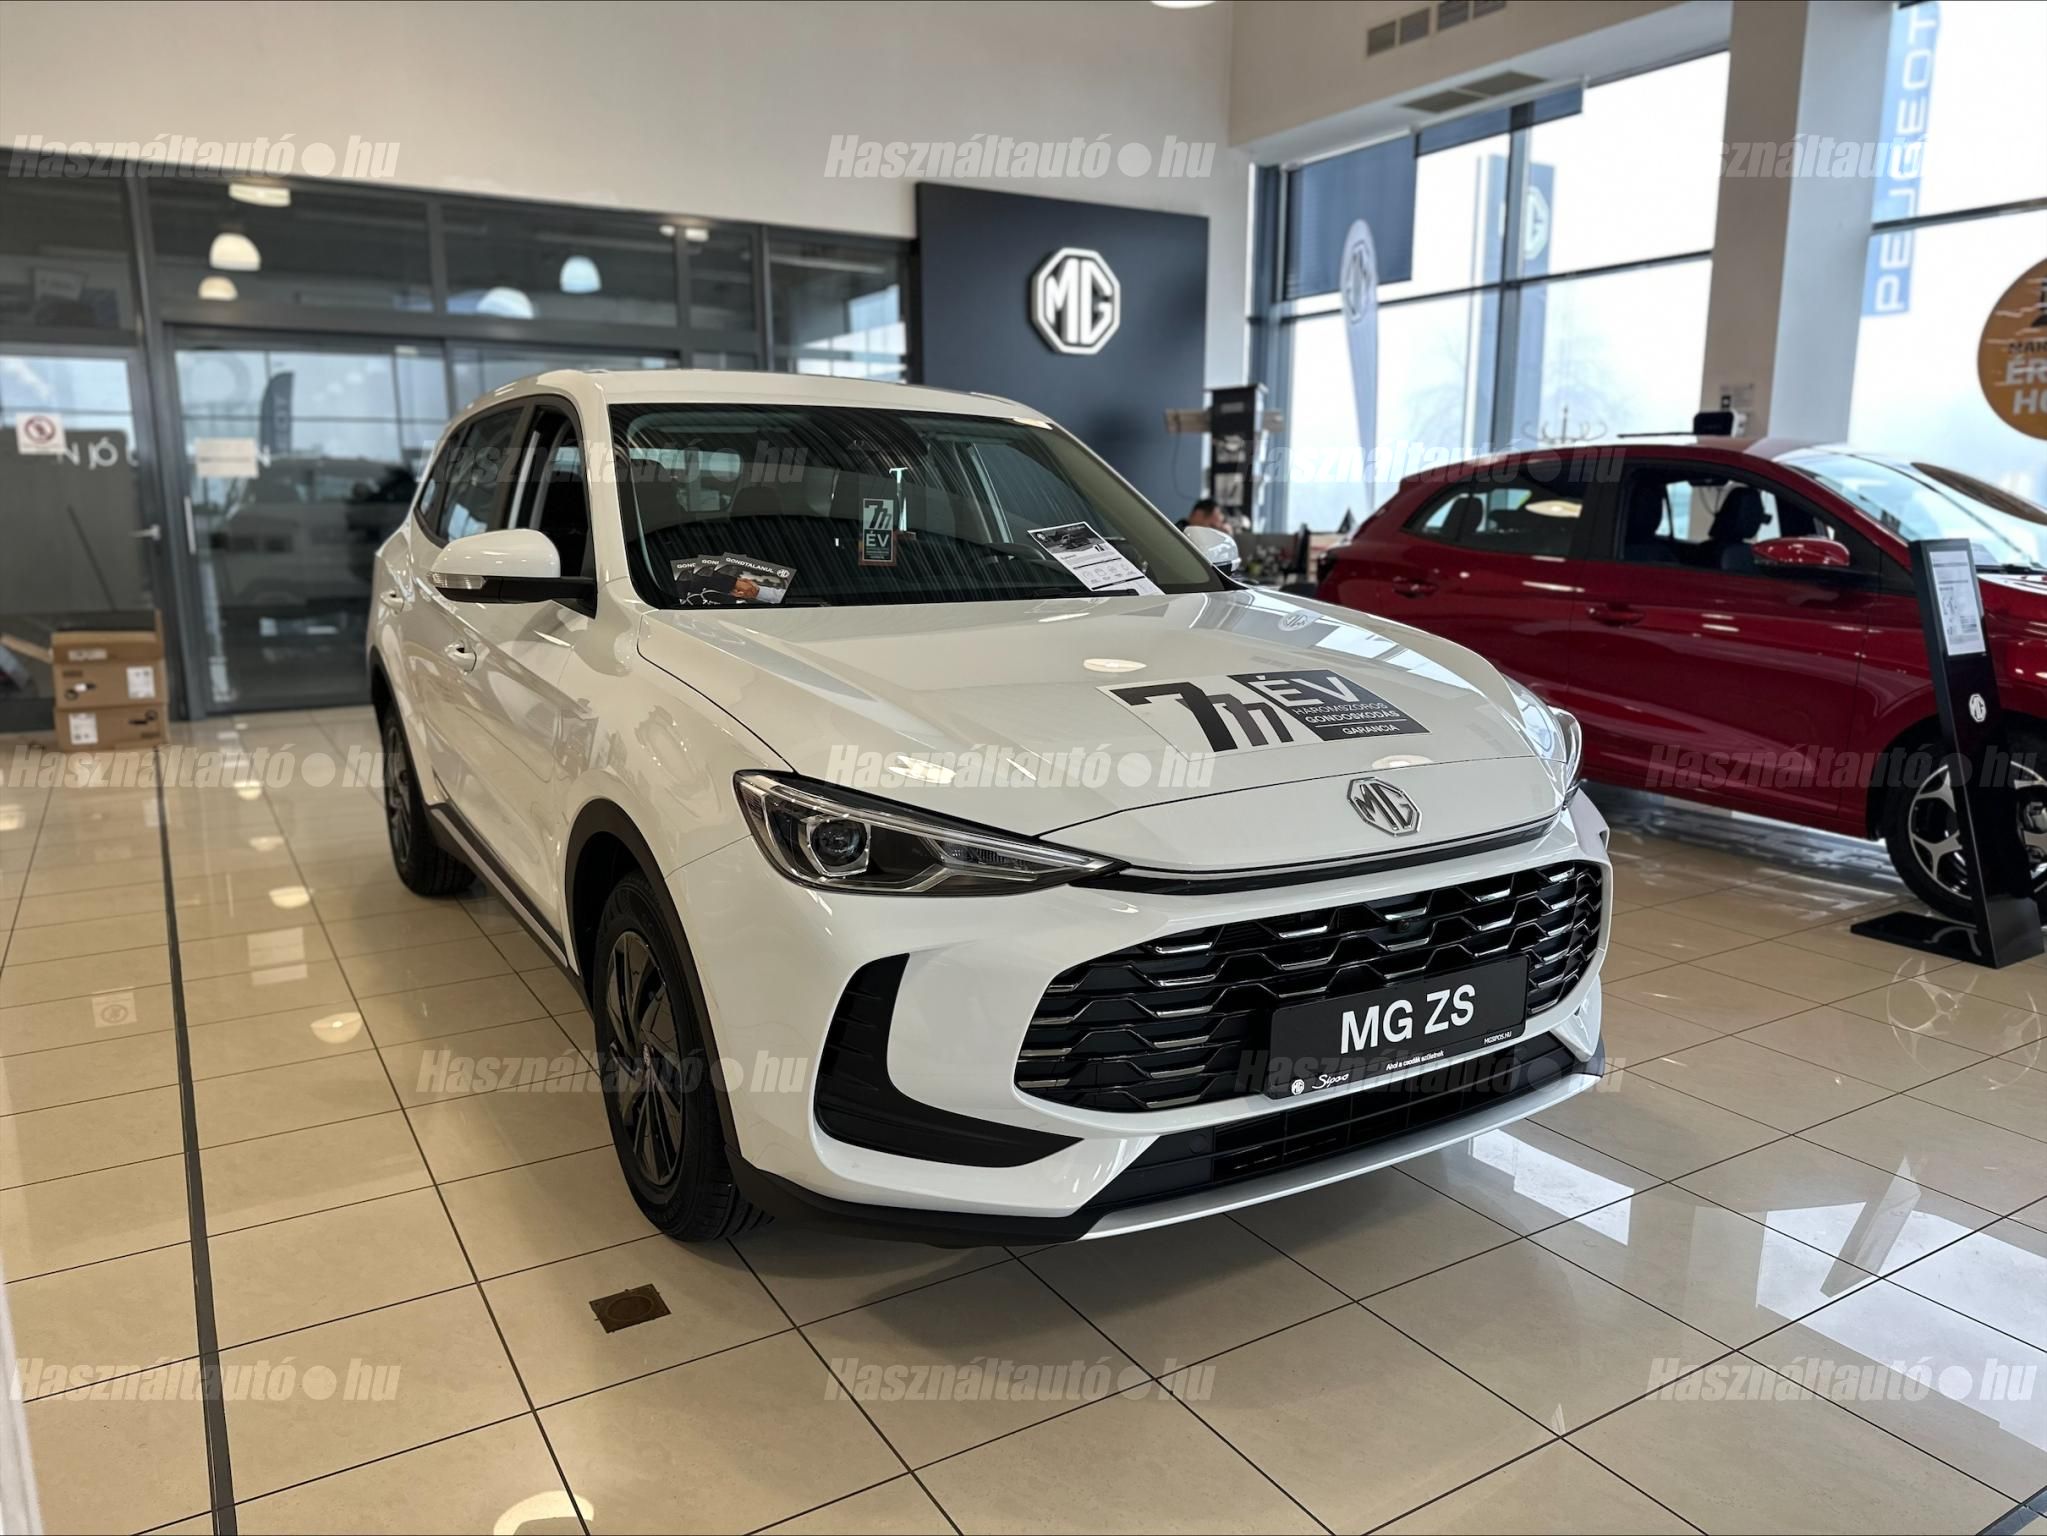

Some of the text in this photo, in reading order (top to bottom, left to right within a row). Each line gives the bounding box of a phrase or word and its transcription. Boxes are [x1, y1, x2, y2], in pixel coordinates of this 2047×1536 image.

[1874, 4, 1938, 313] PEUGEOT
[1042, 255, 1115, 347] MG
[866, 531, 889, 547] ÉV
[726, 557, 774, 573] GONDTALANUL
[1246, 675, 1360, 707] ÉV
[1305, 710, 1400, 724] GONDOSKODÁS
[1342, 723, 1400, 735] GARANCIA
[1352, 781, 1418, 832] MG
[1340, 984, 1476, 1054] MG ZS
